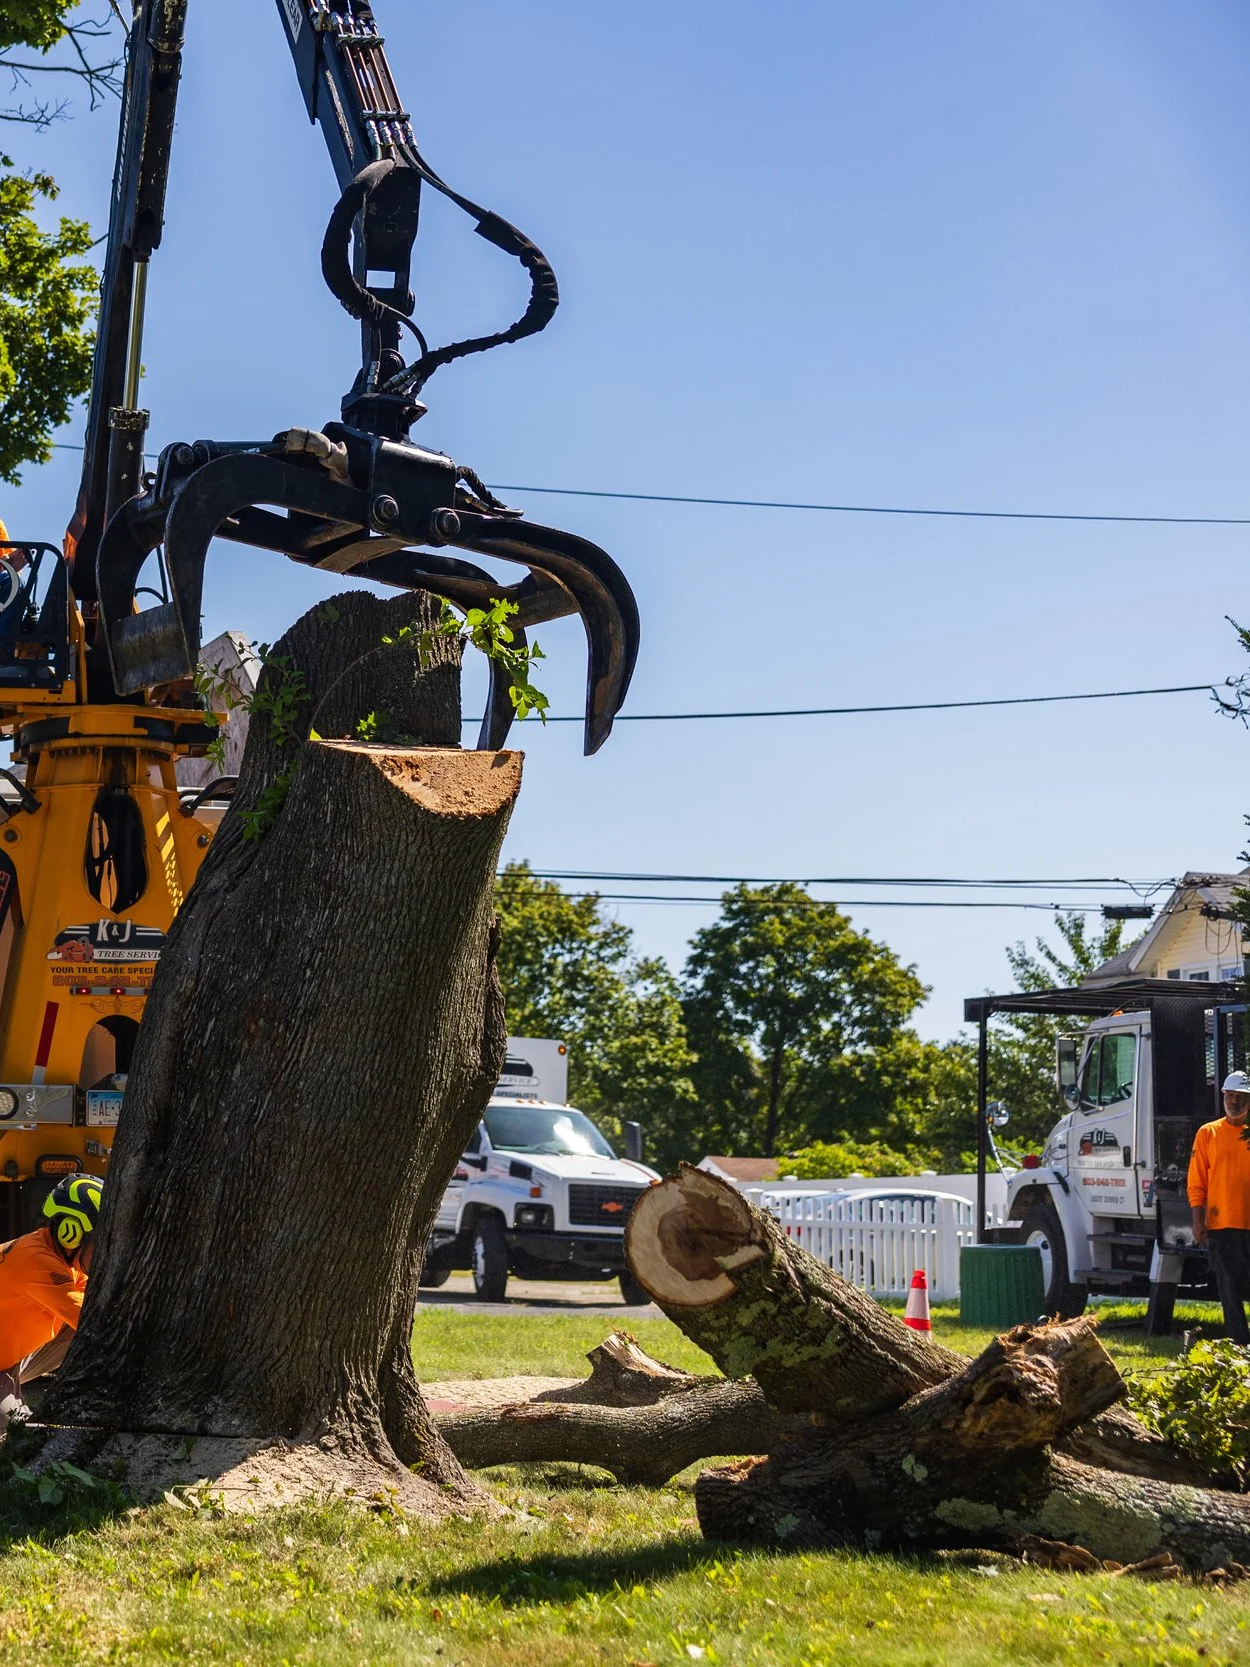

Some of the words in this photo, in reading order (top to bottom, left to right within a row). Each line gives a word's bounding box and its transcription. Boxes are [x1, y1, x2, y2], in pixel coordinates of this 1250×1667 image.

[95, 918, 111, 942] K
[111, 924, 119, 936] &
[119, 919, 132, 943] J
[97, 950, 125, 958] TREE
